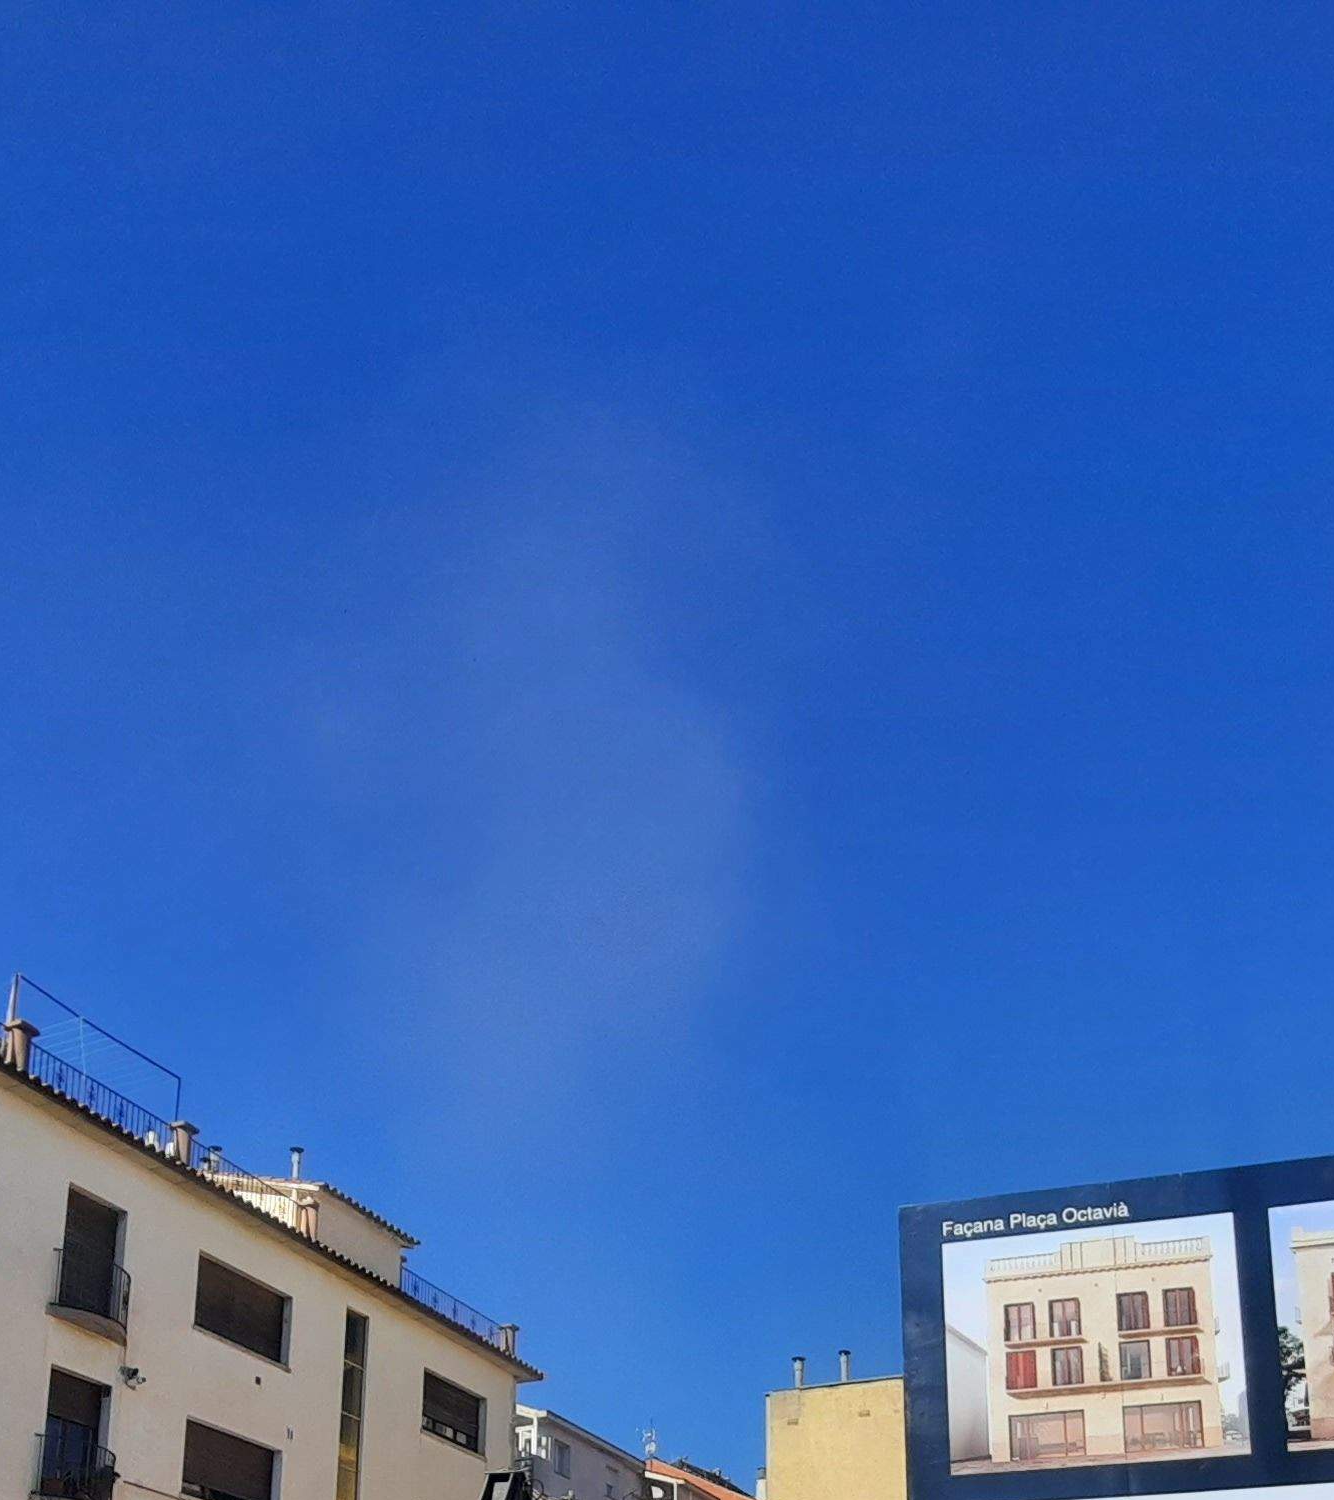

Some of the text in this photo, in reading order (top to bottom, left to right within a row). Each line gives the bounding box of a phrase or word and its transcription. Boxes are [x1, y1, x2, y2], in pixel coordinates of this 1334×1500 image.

[942, 1202, 1130, 1237] Façana Plaça Octavià
